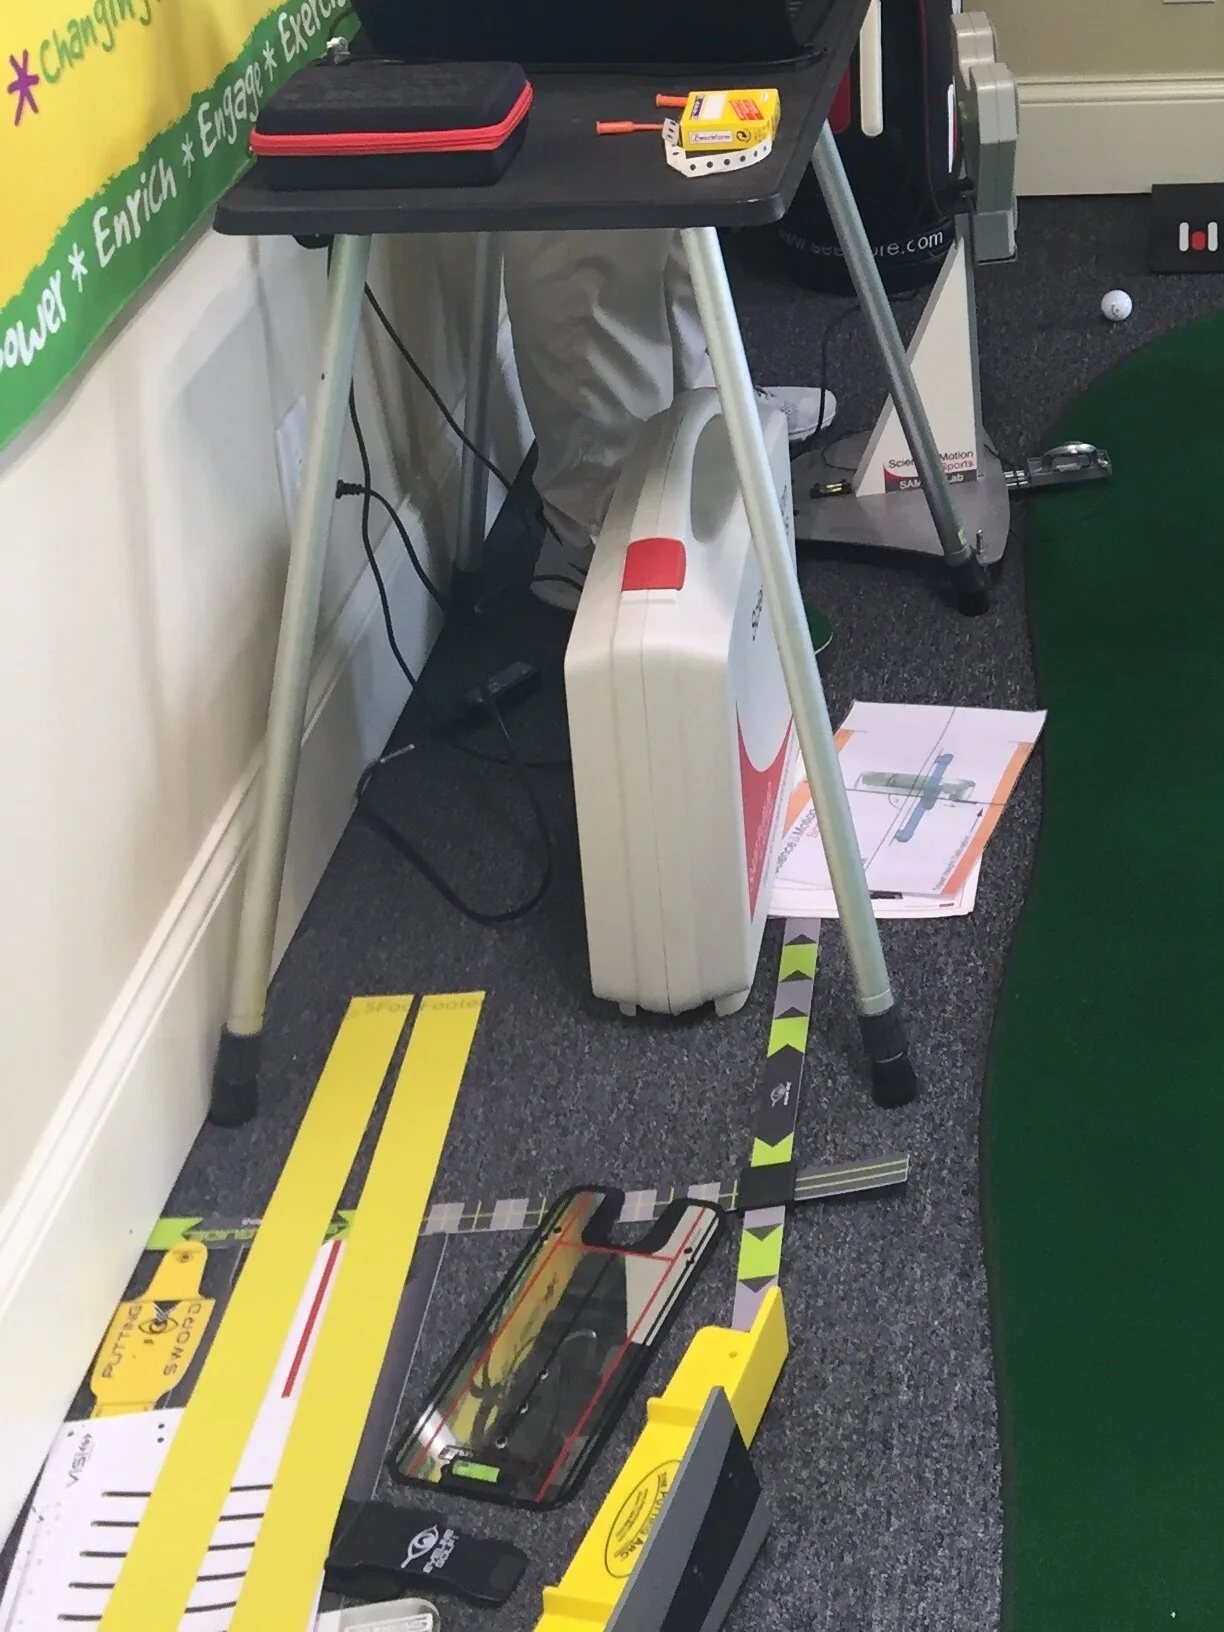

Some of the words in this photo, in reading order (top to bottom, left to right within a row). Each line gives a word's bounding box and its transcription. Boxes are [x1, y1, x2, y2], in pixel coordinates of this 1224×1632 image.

[0, 269, 67, 372] ower
[92, 157, 177, 268] Enrich
[198, 61, 264, 159] Engage
[101, 1302, 143, 1379] PUTTING
[162, 1302, 203, 1376] SWORD
